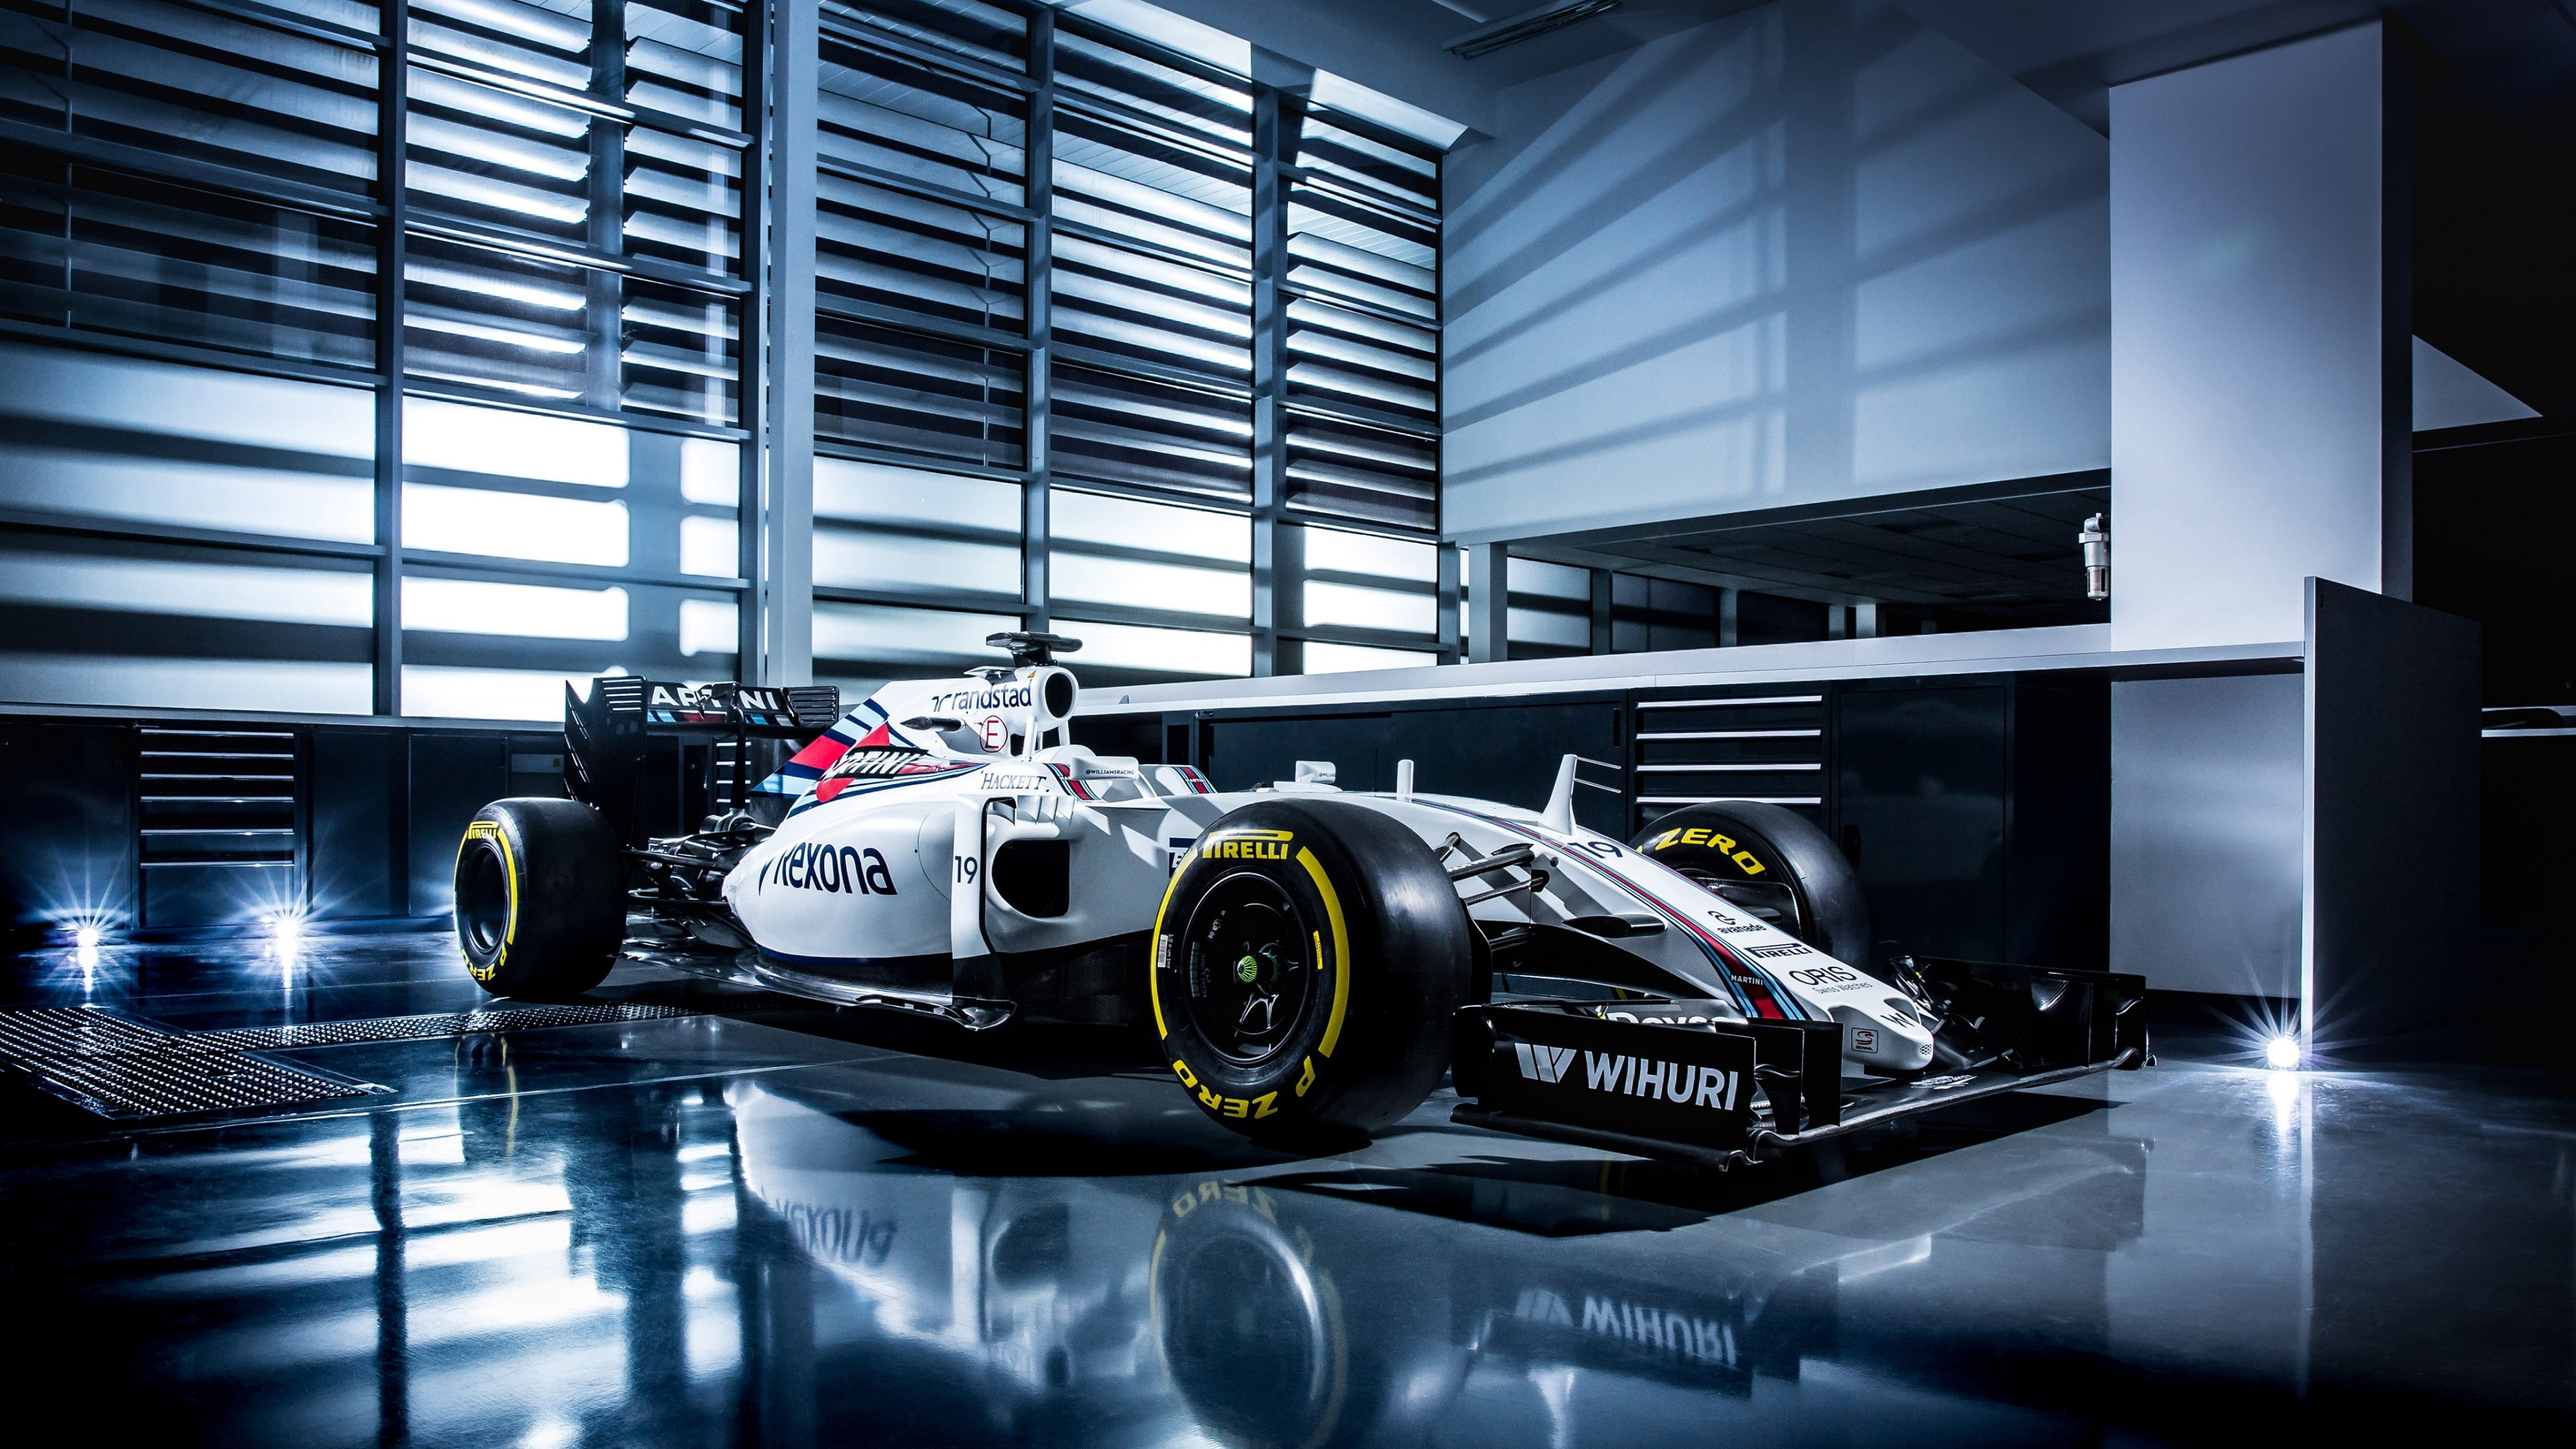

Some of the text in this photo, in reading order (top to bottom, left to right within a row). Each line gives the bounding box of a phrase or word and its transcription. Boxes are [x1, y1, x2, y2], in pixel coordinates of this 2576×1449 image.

[951, 679, 1032, 710] randstad
[981, 773, 1046, 790] HACKETT
[468, 820, 500, 839] PIRELLI
[1202, 829, 1293, 859] PIRELLI
[1567, 841, 1623, 859] 19
[1654, 827, 1766, 875] ZERO
[773, 841, 898, 895] Rexona
[955, 855, 979, 884] 19
[1717, 924, 1767, 934] avanade
[1743, 943, 1813, 958] PIRELLI
[1731, 976, 1764, 985] MARTINI
[1788, 966, 1858, 985] ORIS
[1812, 981, 1874, 994] Swiss Watches
[1172, 1055, 1316, 1120] P ZERO
[1585, 1051, 1739, 1111] WIHURI
